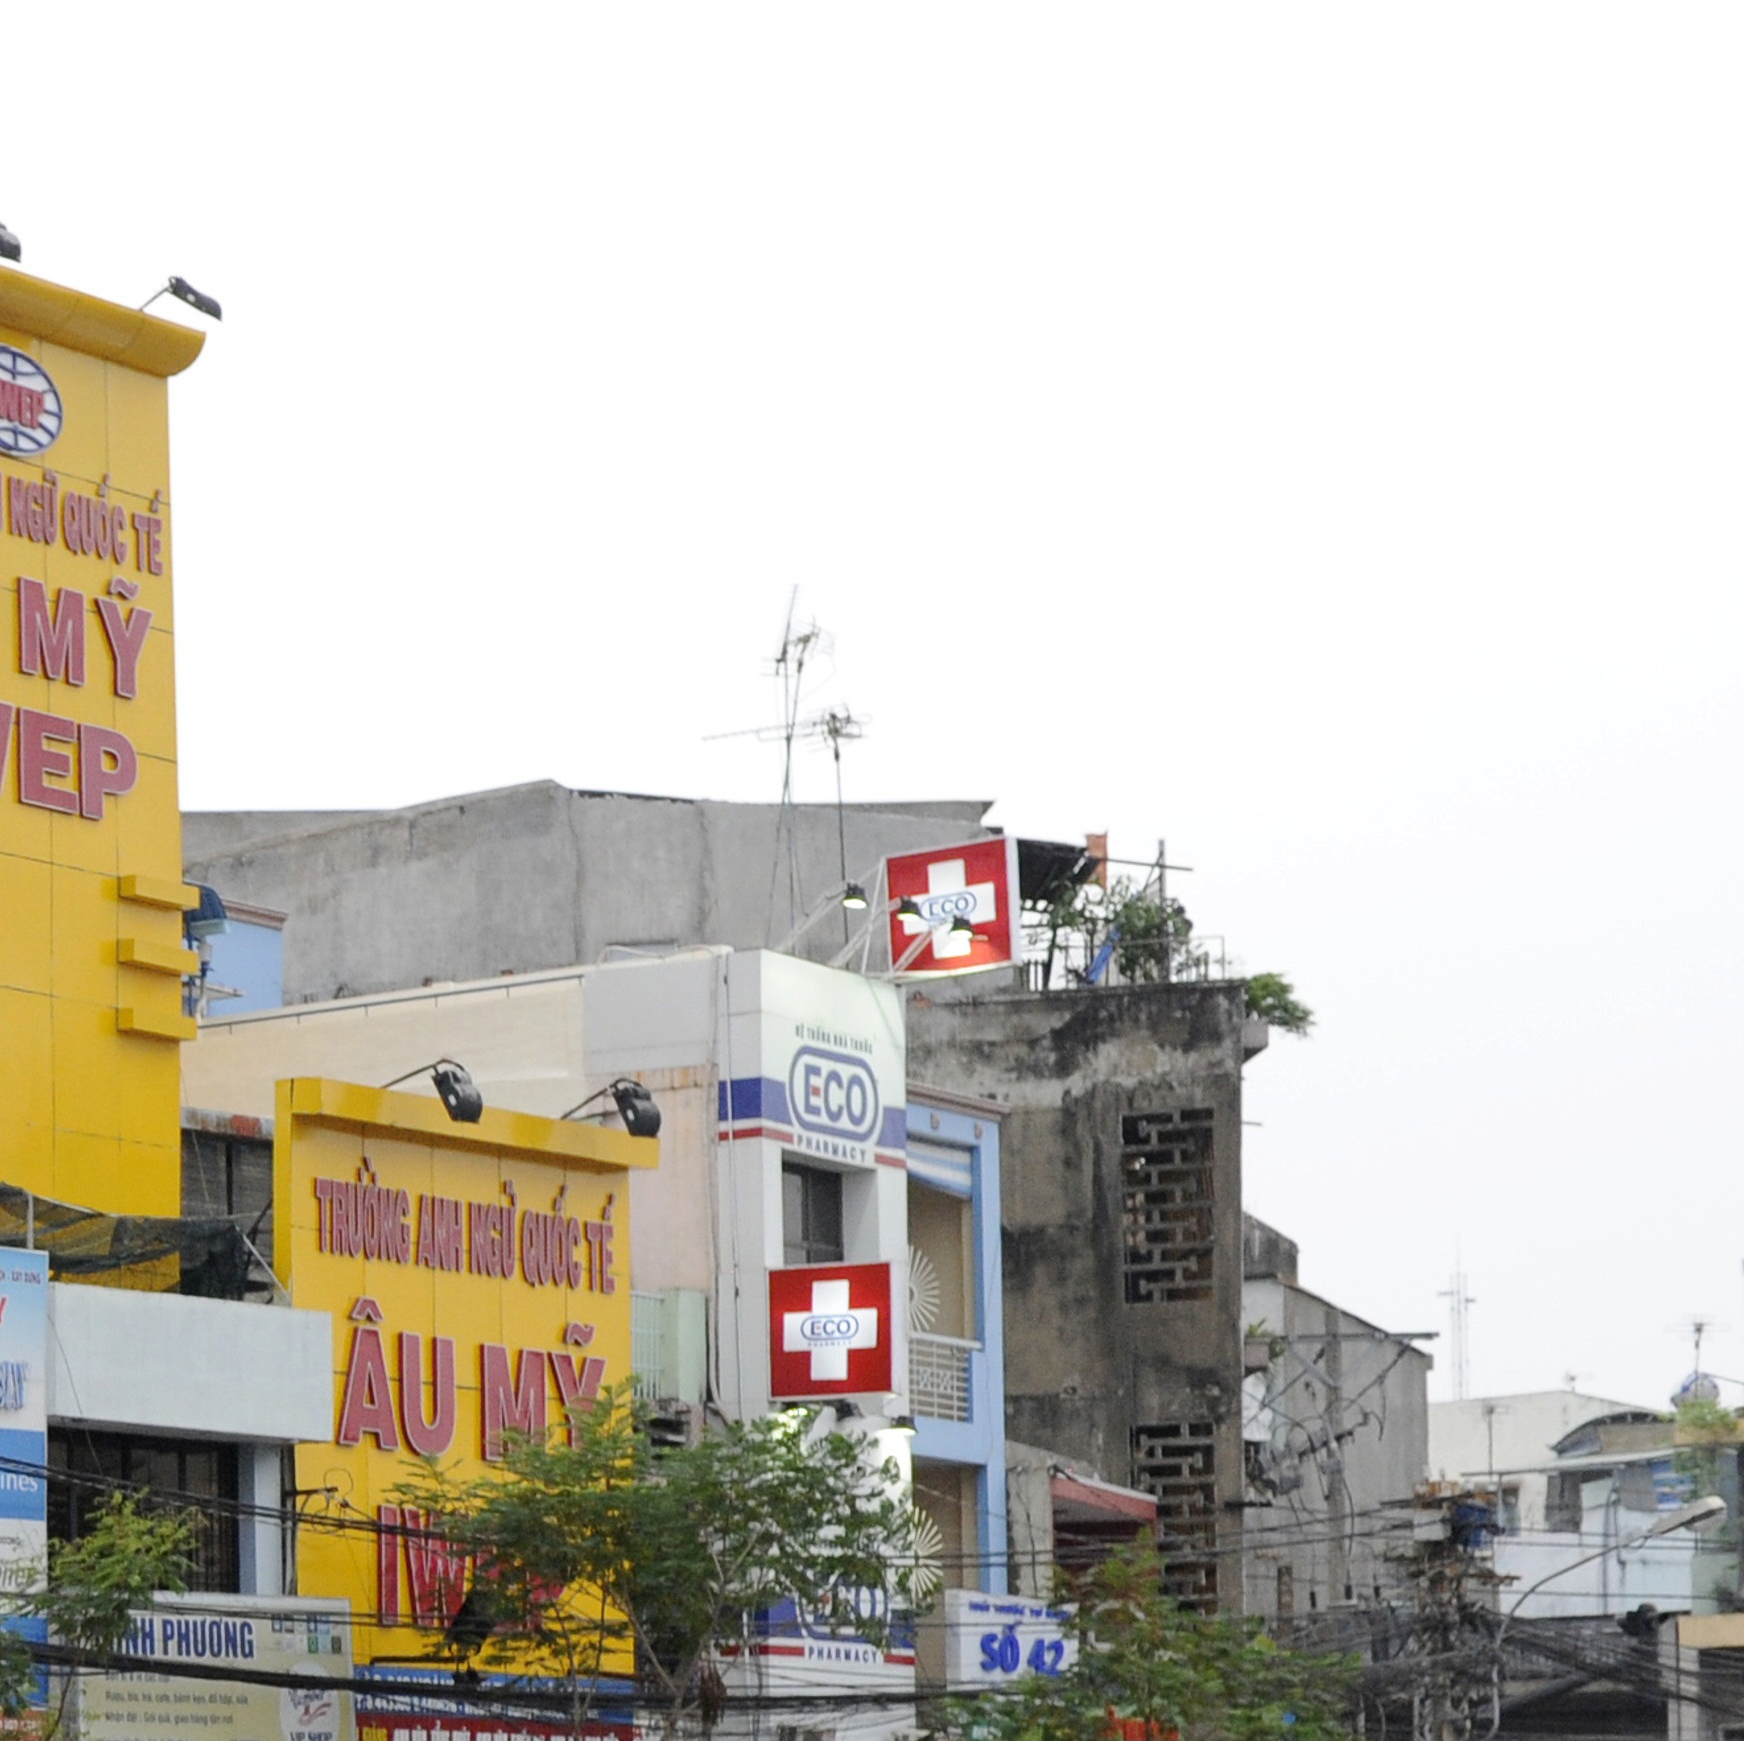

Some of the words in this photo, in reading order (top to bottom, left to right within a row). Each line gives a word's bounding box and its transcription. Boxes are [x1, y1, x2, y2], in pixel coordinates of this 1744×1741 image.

[9, 470, 58, 545] NGỮ
[64, 473, 128, 565] QUỐC
[133, 490, 164, 576] TẾ
[18, 577, 153, 700] MỸ
[928, 894, 969, 918] ECO
[804, 1063, 867, 1127] ECO
[797, 1134, 866, 1162] PHARMACY
[315, 1157, 411, 1264] TRƯỜNG
[416, 1193, 464, 1272] ANH
[470, 1180, 516, 1279] NGỮ
[522, 1184, 581, 1289] QUỐC
[586, 1194, 615, 1294] TẾ
[811, 1318, 851, 1338] ECO
[338, 1297, 456, 1456] ÂU
[481, 1322, 607, 1461] MỸ
[162, 1615, 254, 1659] PHƯƠNG
[809, 1646, 877, 1663] PHARMACY
[980, 1620, 1022, 1673] SỐ
[1027, 1638, 1065, 1677] 42
